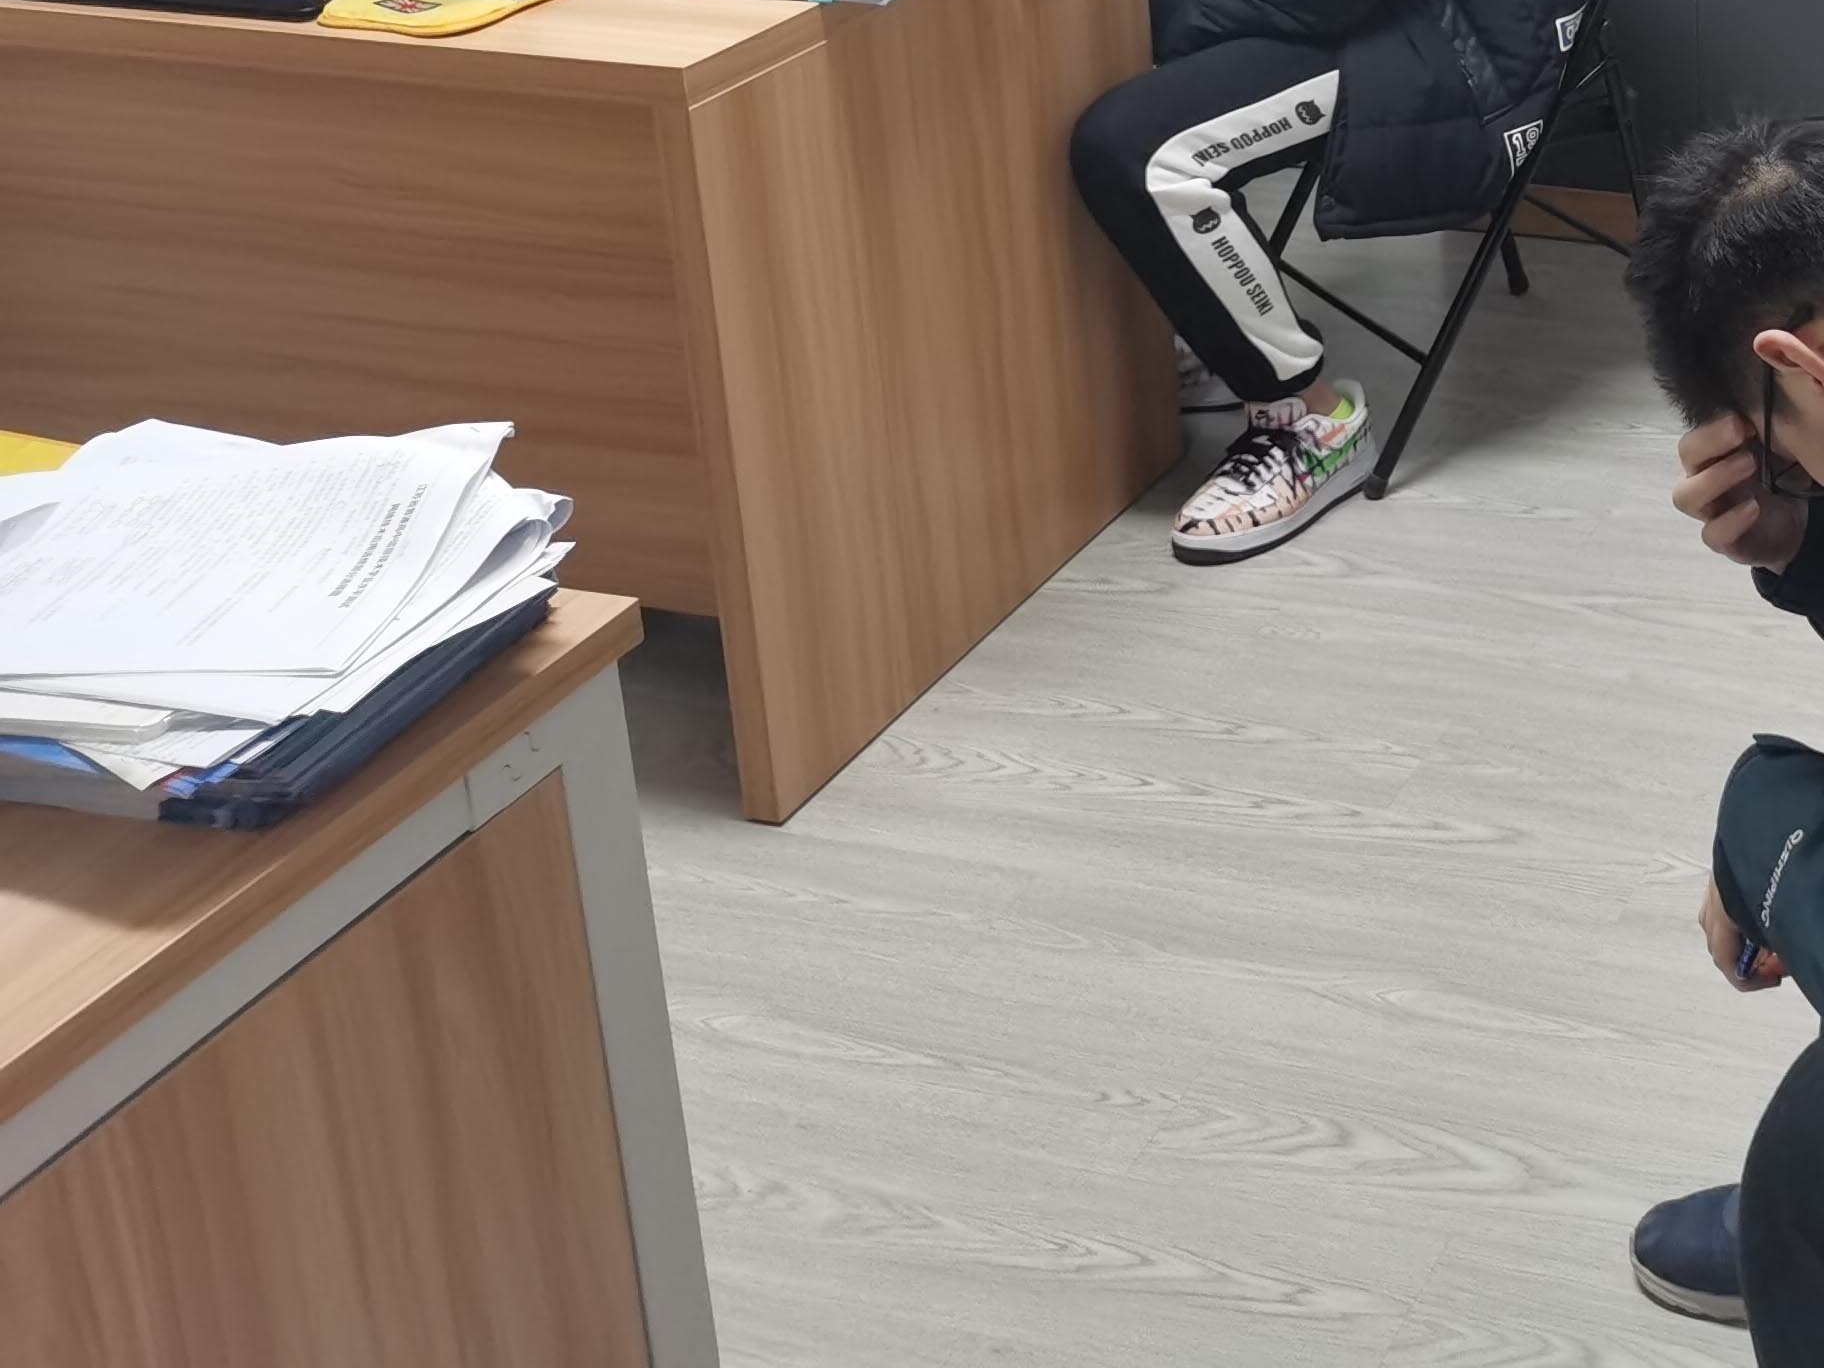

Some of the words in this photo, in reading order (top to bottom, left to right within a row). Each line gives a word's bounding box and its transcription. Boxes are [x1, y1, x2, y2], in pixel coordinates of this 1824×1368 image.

[1230, 117, 1293, 150] HOPPOU
[1211, 235, 1257, 287] HOPPOU
[1246, 283, 1275, 317] SEIKI
